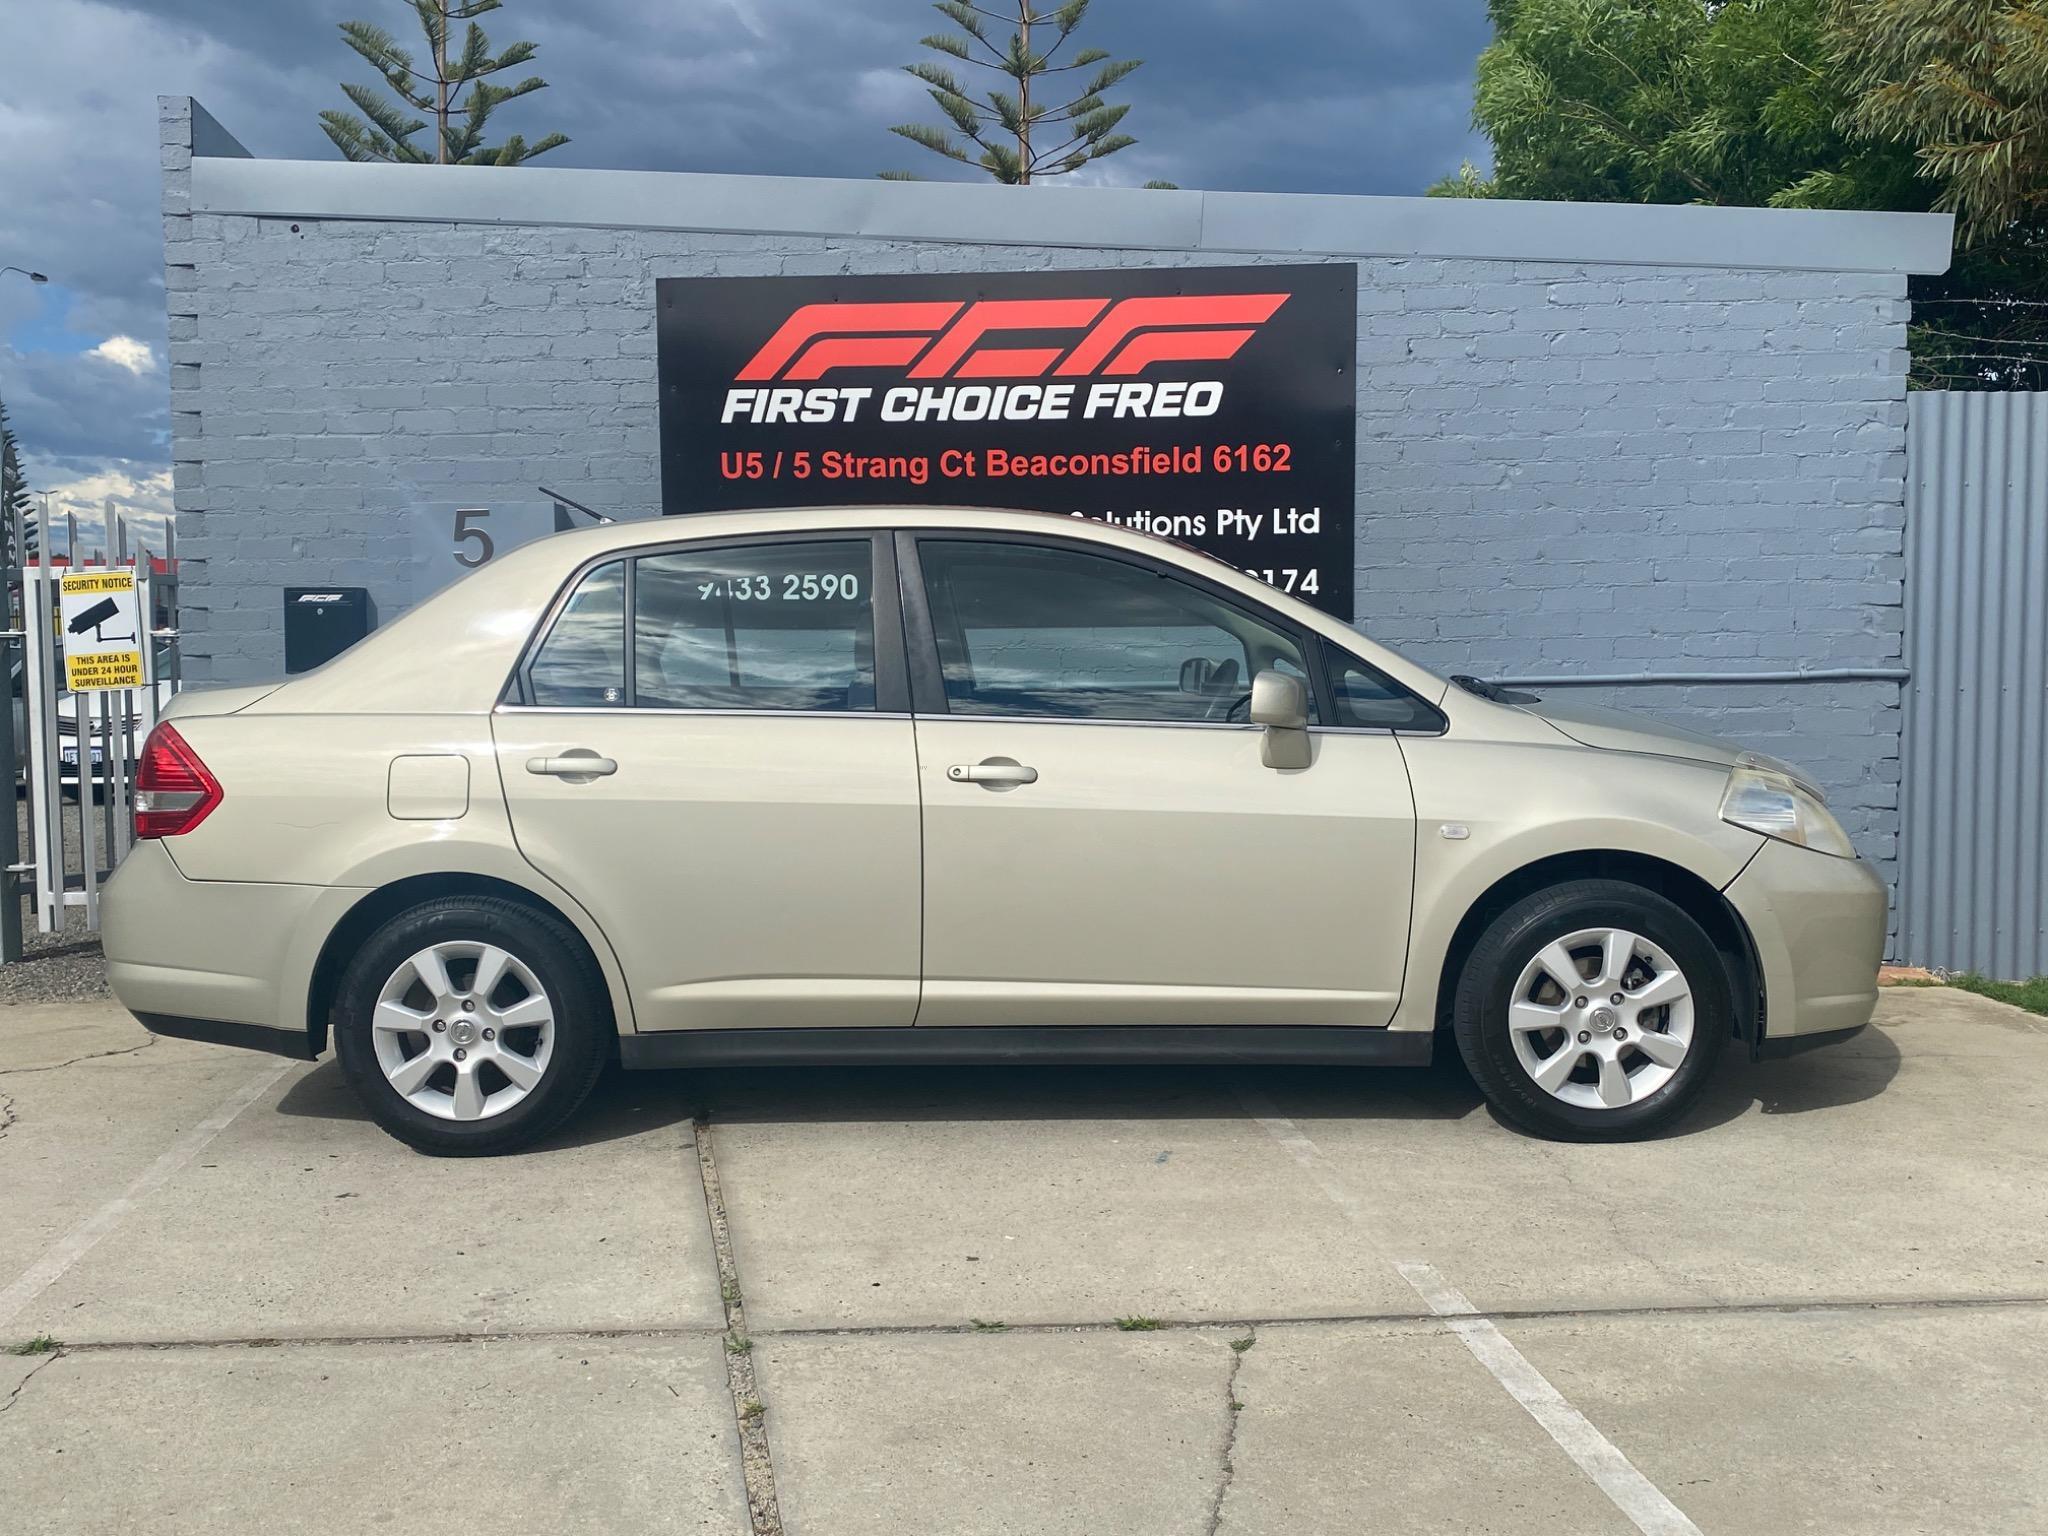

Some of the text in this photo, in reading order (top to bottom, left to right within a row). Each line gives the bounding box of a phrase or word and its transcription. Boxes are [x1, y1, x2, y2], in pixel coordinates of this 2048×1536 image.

[720, 380, 1224, 424] FIRST CHOICE FREO
[720, 443, 1292, 485] U5 / 5 Strang Ct Beaconsfield 6162
[1217, 509, 1264, 541] Pty
[1273, 507, 1320, 535] Ltd
[453, 509, 494, 568] 5
[63, 577, 132, 592] SECURITY NOTICE
[782, 573, 859, 601] 2590
[1245, 568, 1320, 595] 174
[71, 664, 138, 676] UNDER 24 HOUR
[76, 653, 130, 665] THIS AREA IS
[74, 675, 136, 688] SURVEILLANCE
